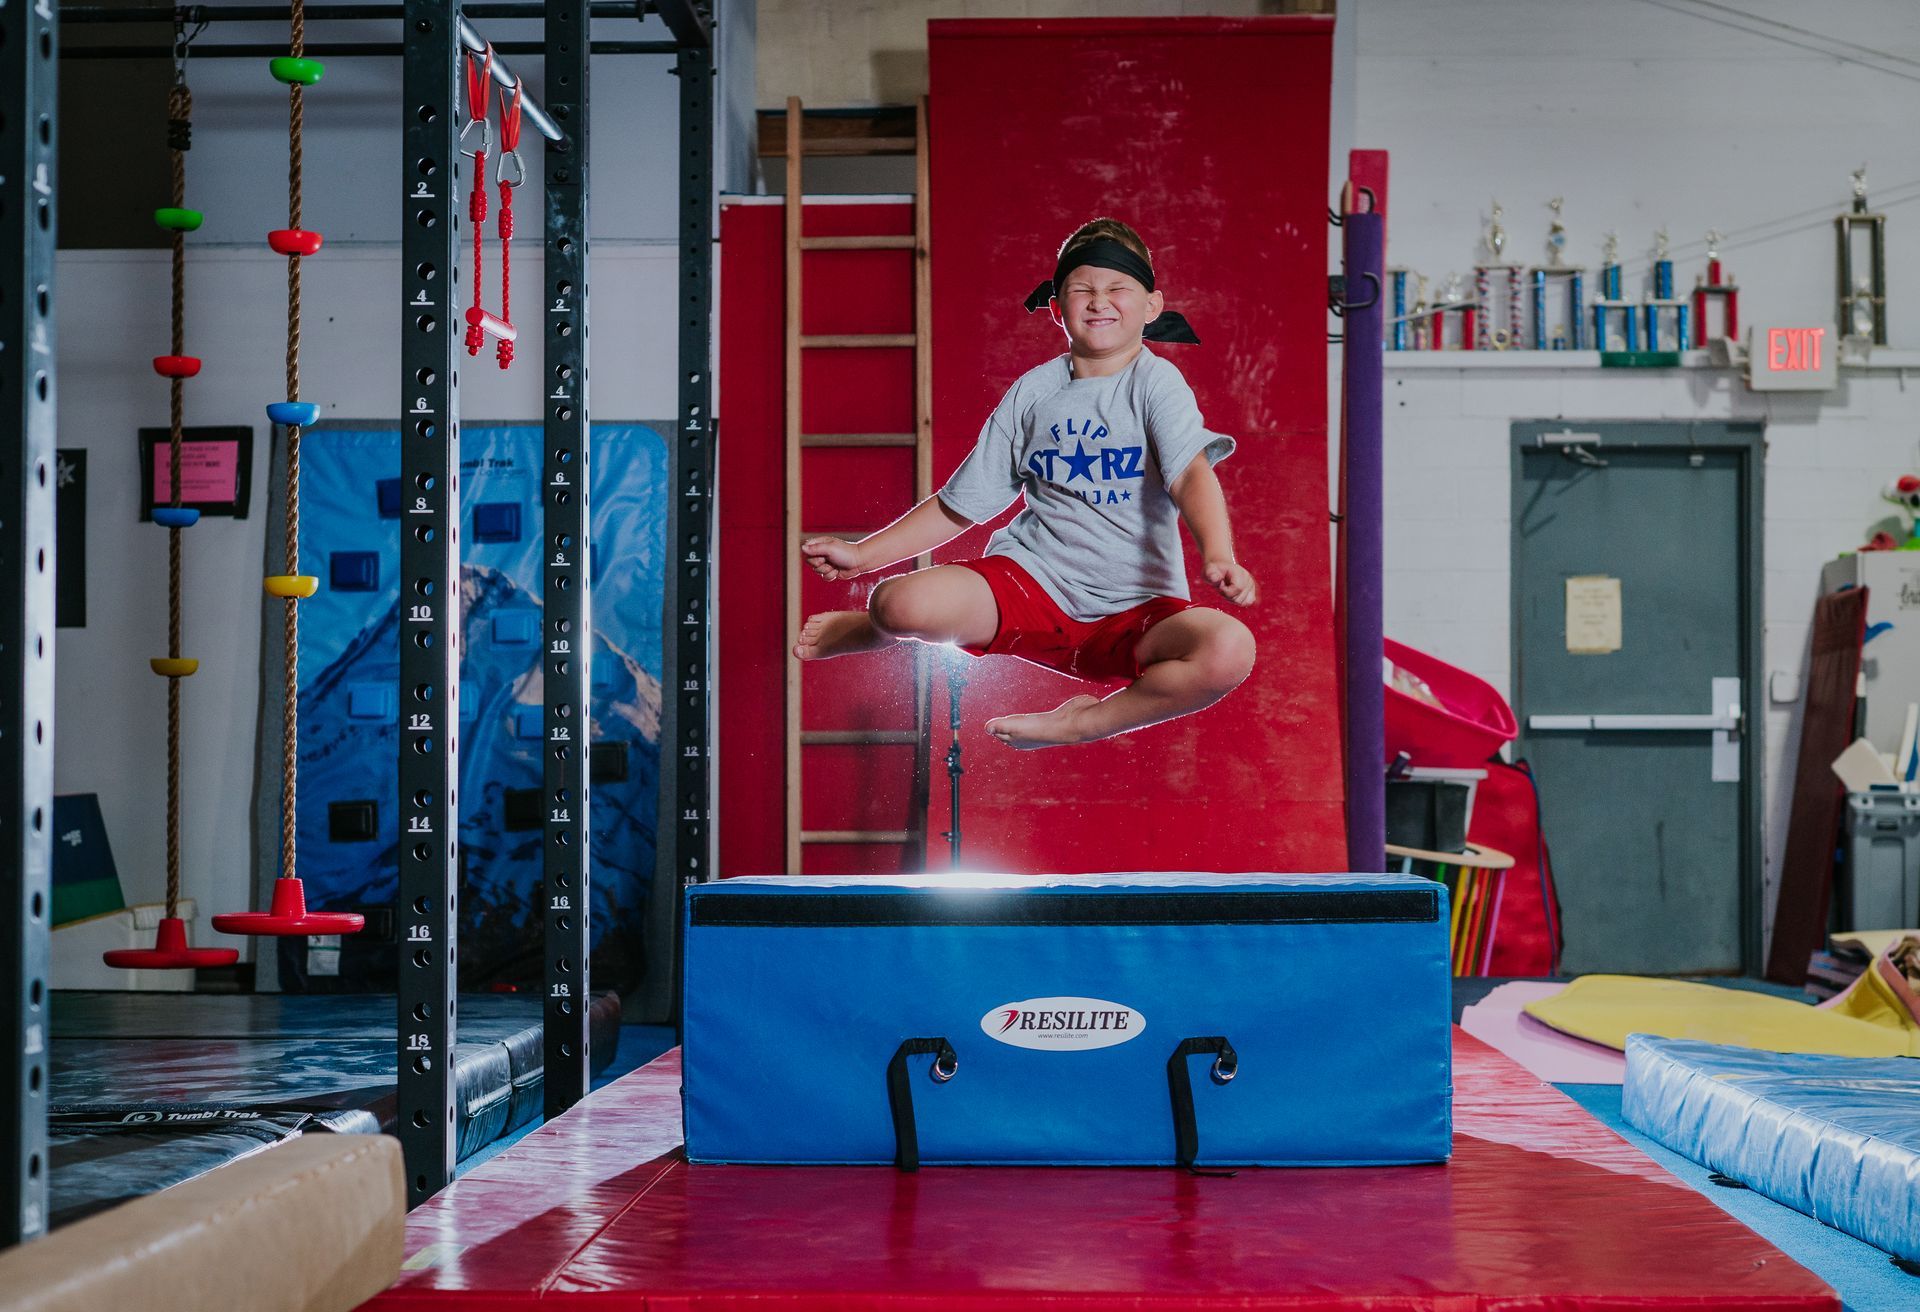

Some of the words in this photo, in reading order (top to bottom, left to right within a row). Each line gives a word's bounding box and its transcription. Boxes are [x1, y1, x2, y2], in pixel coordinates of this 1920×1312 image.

[418, 182, 427, 193] 2
[417, 290, 427, 302] 4
[556, 299, 564, 309] 2
[1767, 327, 1825, 372] EXIT
[556, 386, 564, 395] 4
[417, 398, 426, 409] 6
[1050, 418, 1108, 442] FLIP
[488, 457, 514, 469] Trak
[556, 472, 564, 482] 6
[416, 497, 426, 510] 8
[556, 553, 564, 563] 8
[411, 606, 430, 618] 10
[553, 640, 568, 650] 10
[684, 680, 699, 688] 10
[411, 714, 430, 726] 12
[553, 727, 568, 737] 12
[684, 746, 699, 754] 12
[552, 809, 568, 819] 14
[410, 817, 429, 829] 14
[553, 896, 568, 906] 16
[410, 926, 429, 938] 16
[553, 984, 568, 994] 18
[1020, 1011, 1130, 1030] RESILITE
[409, 1034, 429, 1047] 18
[1037, 1032, 1089, 1040] www.resilite.com
[167, 1110, 220, 1121] Tumbl
[224, 1110, 261, 1119] Trak
